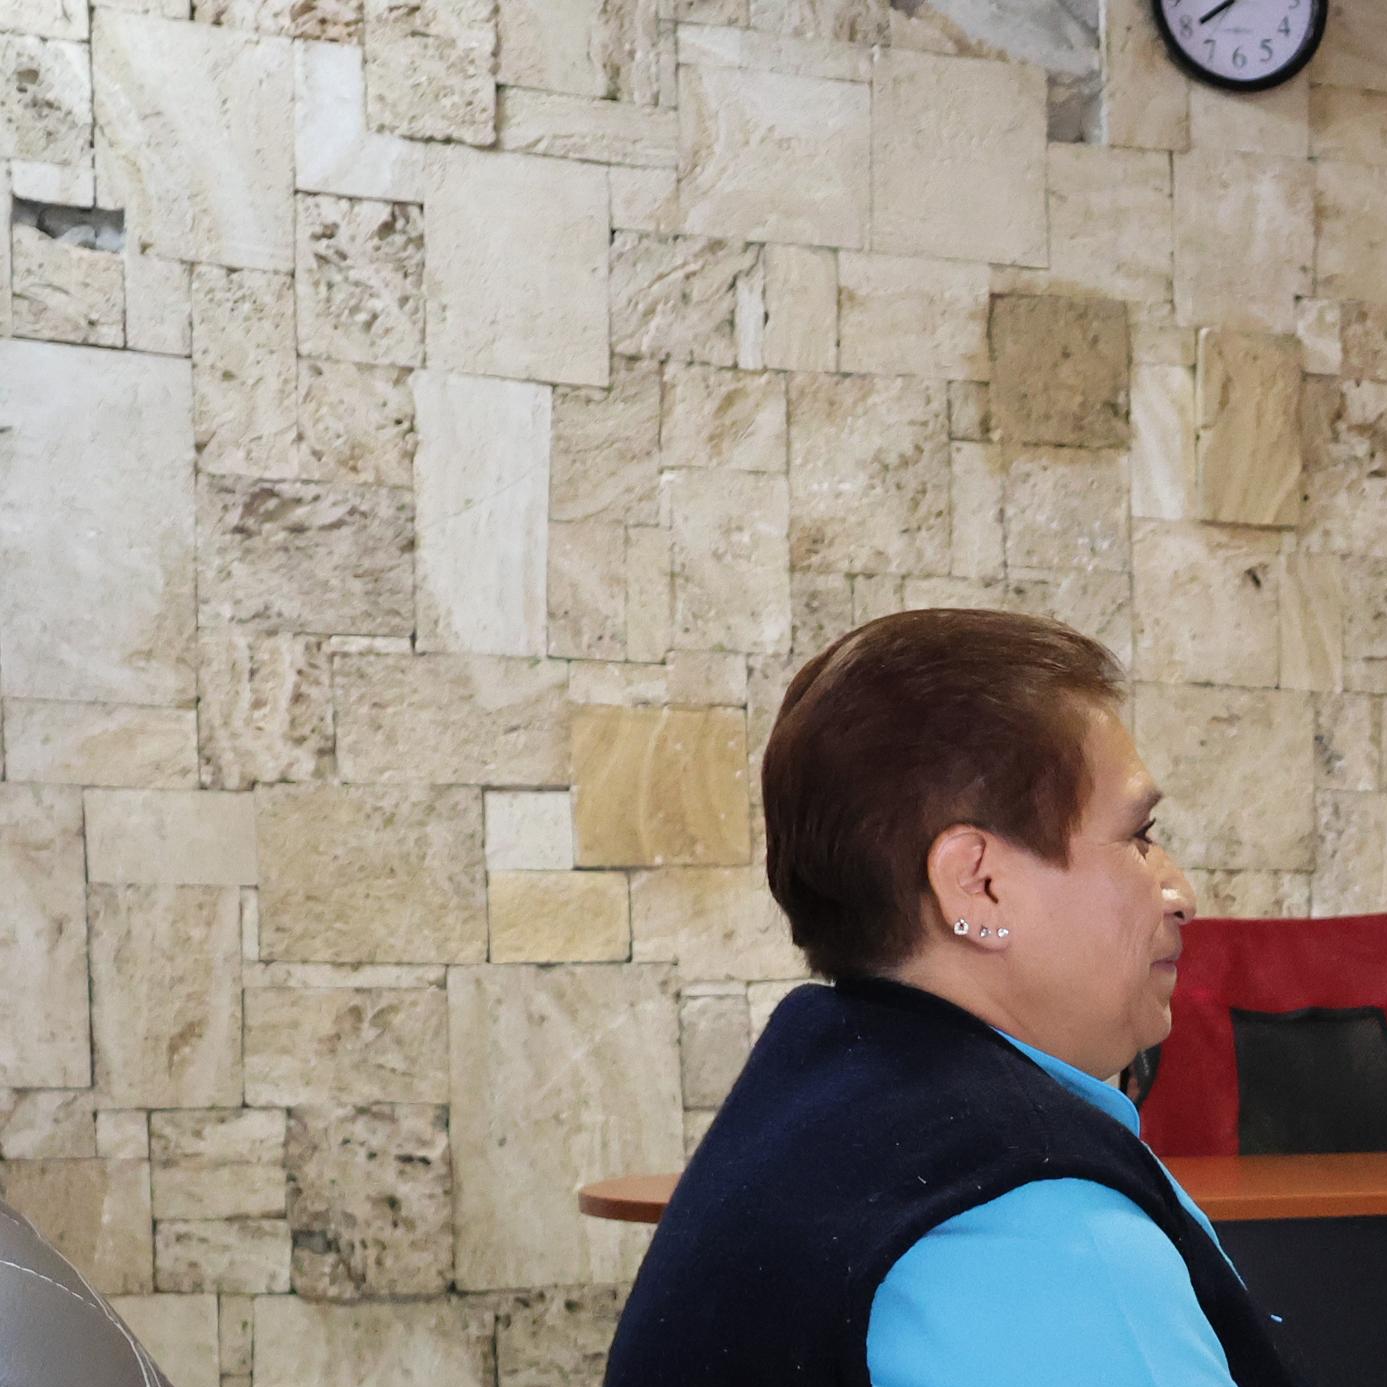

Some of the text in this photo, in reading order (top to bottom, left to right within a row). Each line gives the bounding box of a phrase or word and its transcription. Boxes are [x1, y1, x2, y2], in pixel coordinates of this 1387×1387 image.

[1179, 15, 1193, 38] 8
[1277, 16, 1291, 36] 4
[1203, 39, 1216, 62] 7
[1232, 47, 1247, 68] 6
[1260, 39, 1273, 62] 5
